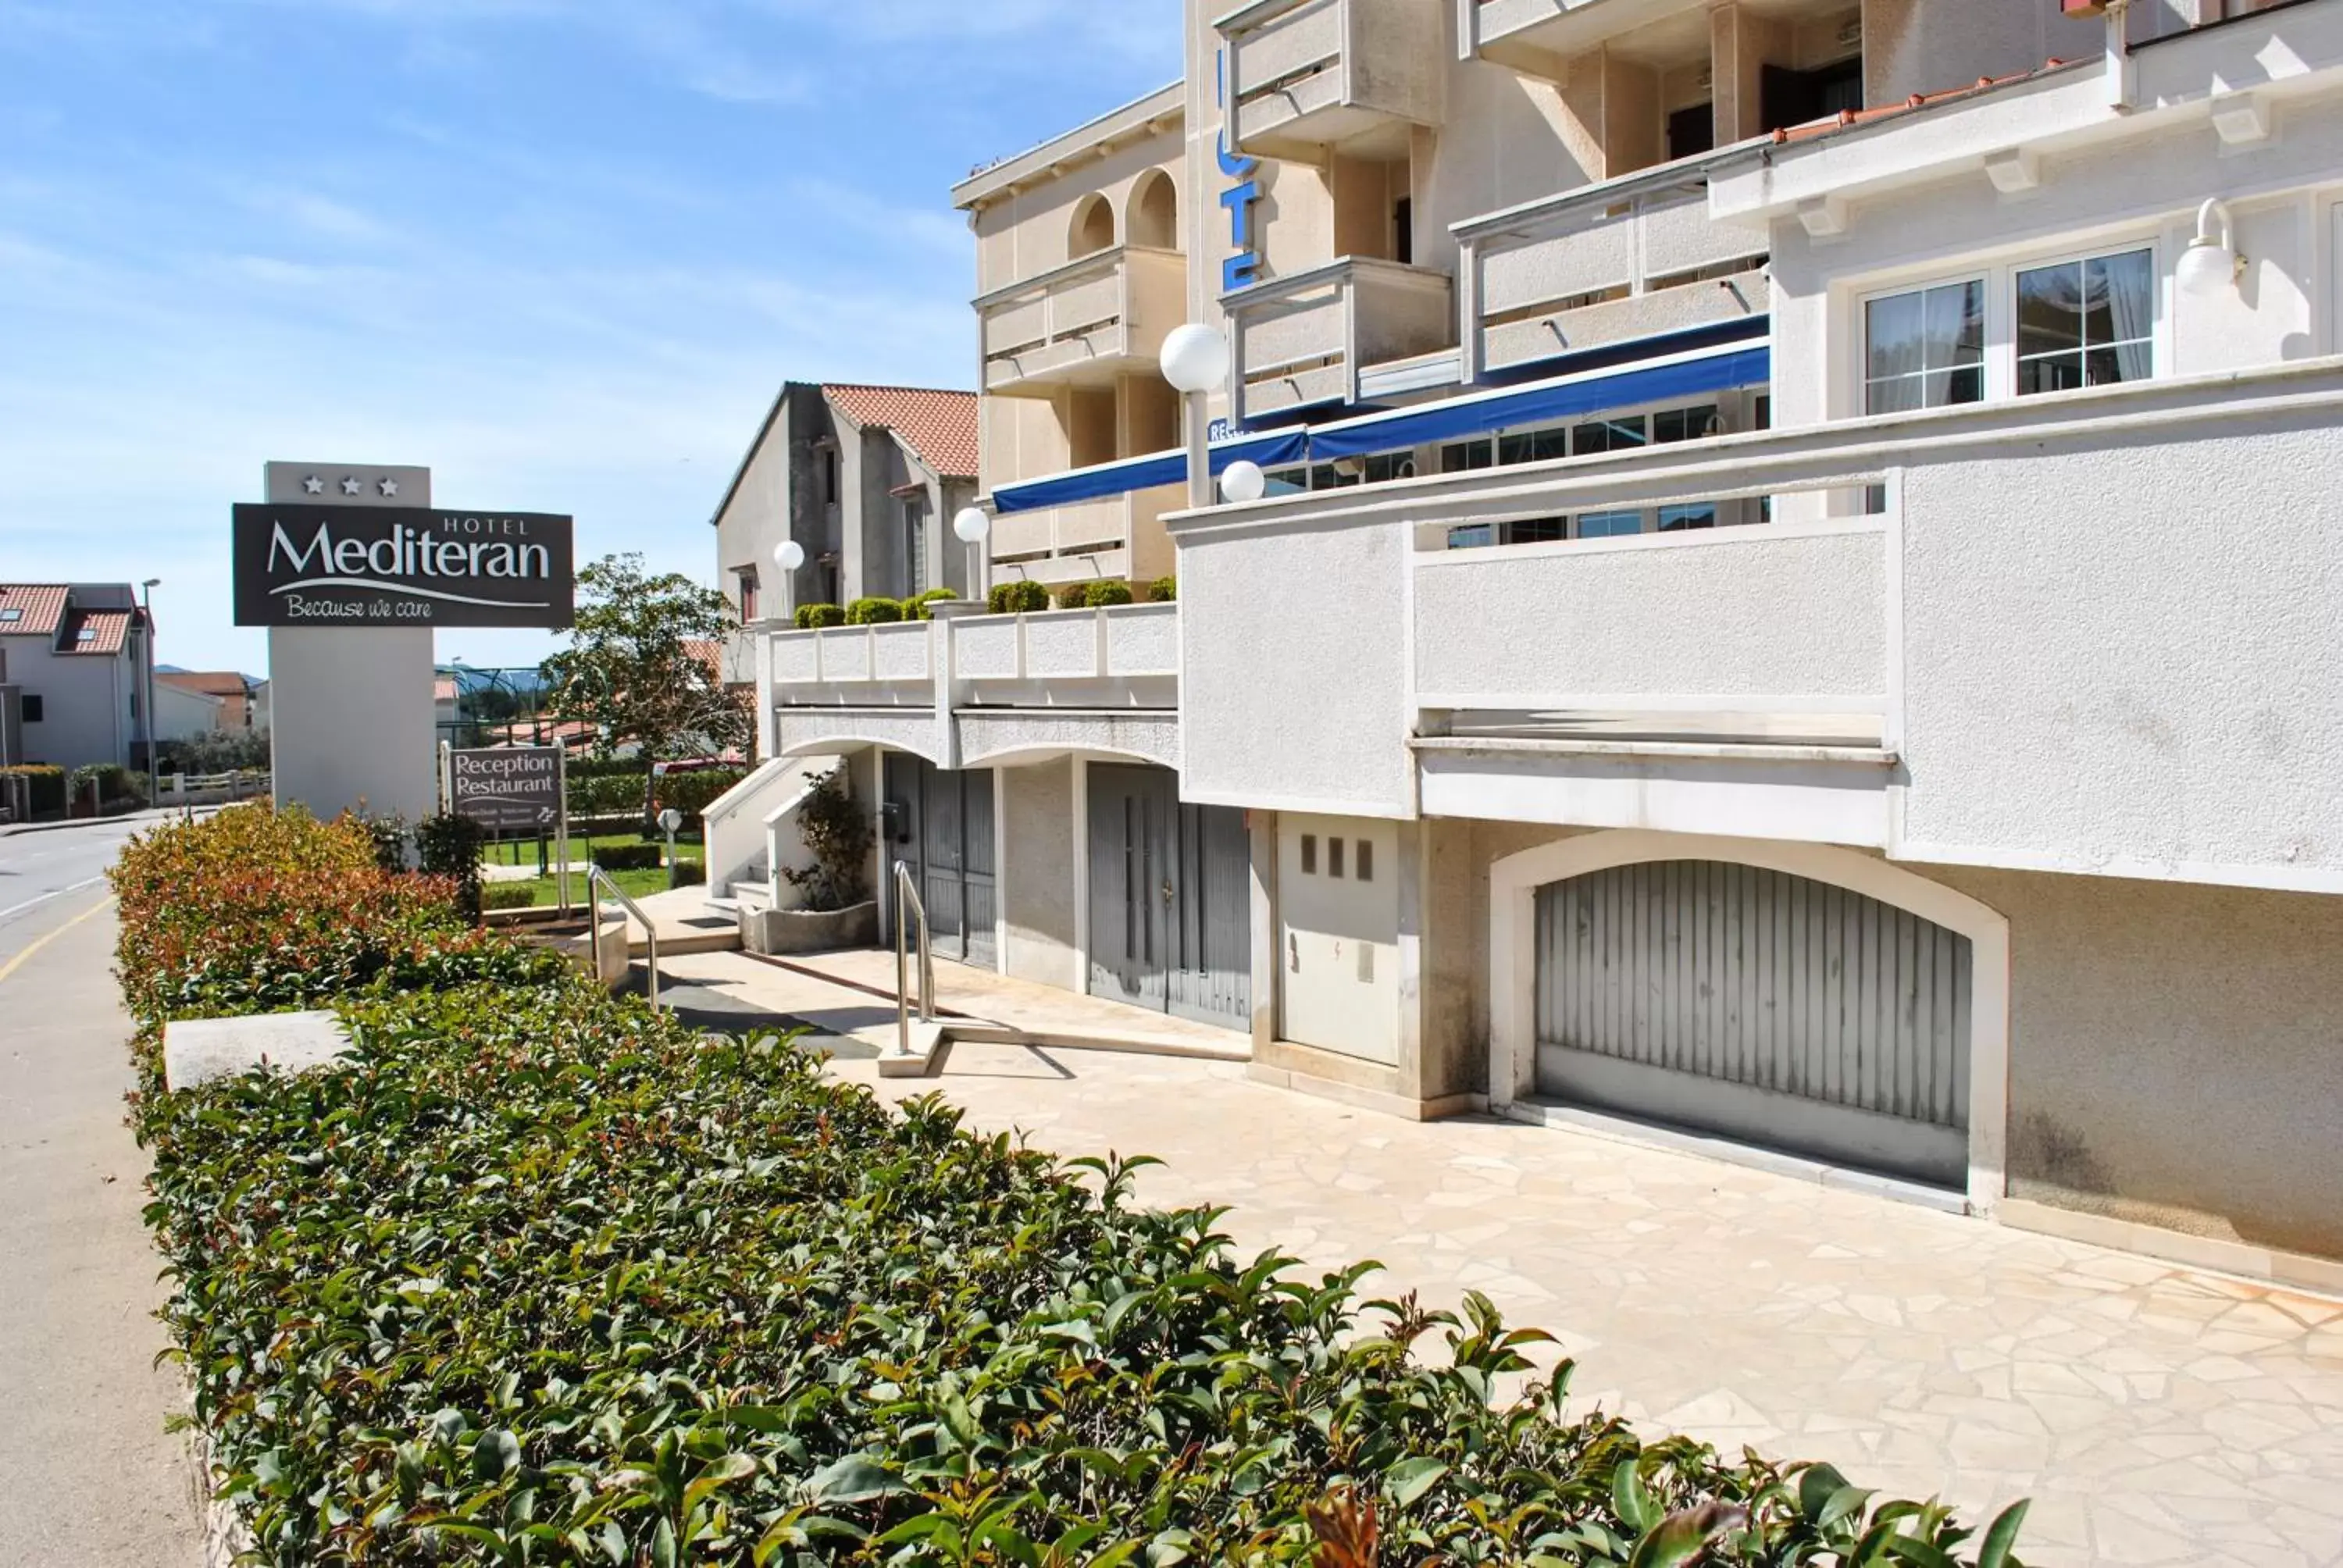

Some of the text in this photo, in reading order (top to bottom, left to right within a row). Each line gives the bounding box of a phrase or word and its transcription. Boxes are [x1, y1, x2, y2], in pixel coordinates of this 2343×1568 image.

[443, 517, 529, 536] HOTEL
[267, 519, 550, 579] Mediteran
[284, 594, 433, 618] Because we care
[455, 754, 553, 778] Reception
[456, 776, 553, 796] Restaurant
